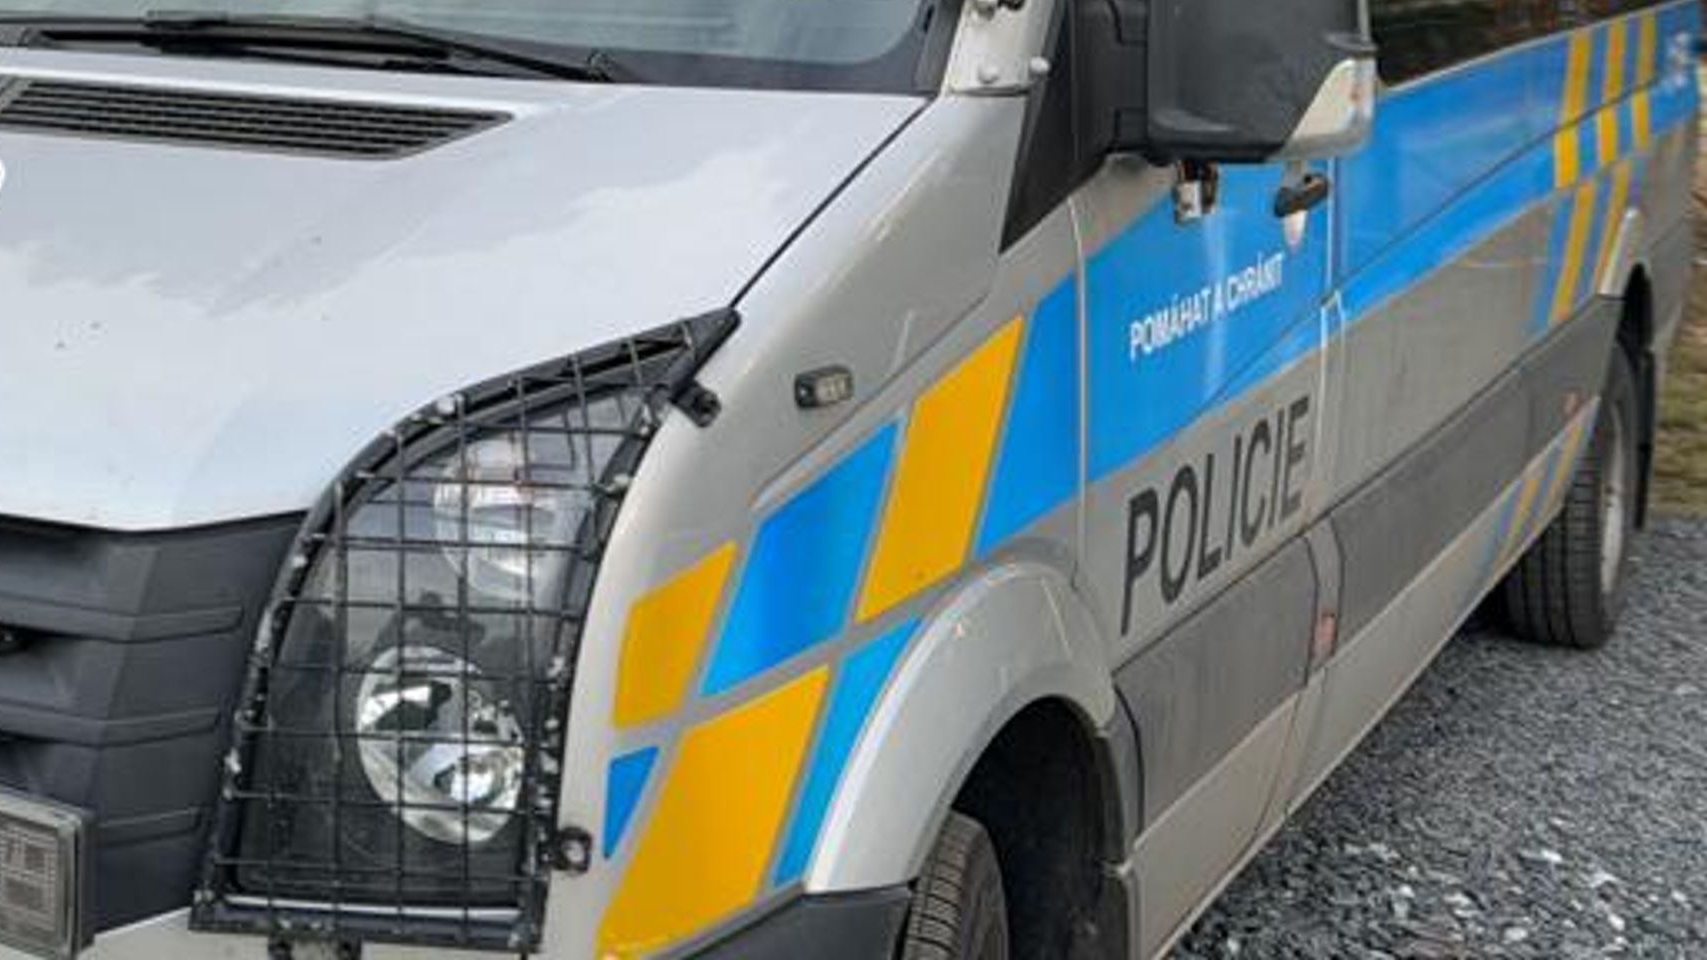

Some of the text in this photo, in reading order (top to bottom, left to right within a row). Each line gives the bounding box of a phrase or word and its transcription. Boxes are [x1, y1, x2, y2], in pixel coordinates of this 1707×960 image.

[1129, 286, 1212, 363] POMÁHAT
[1227, 250, 1286, 313] CHRÁNIT
[1120, 395, 1311, 638] POLICIE
